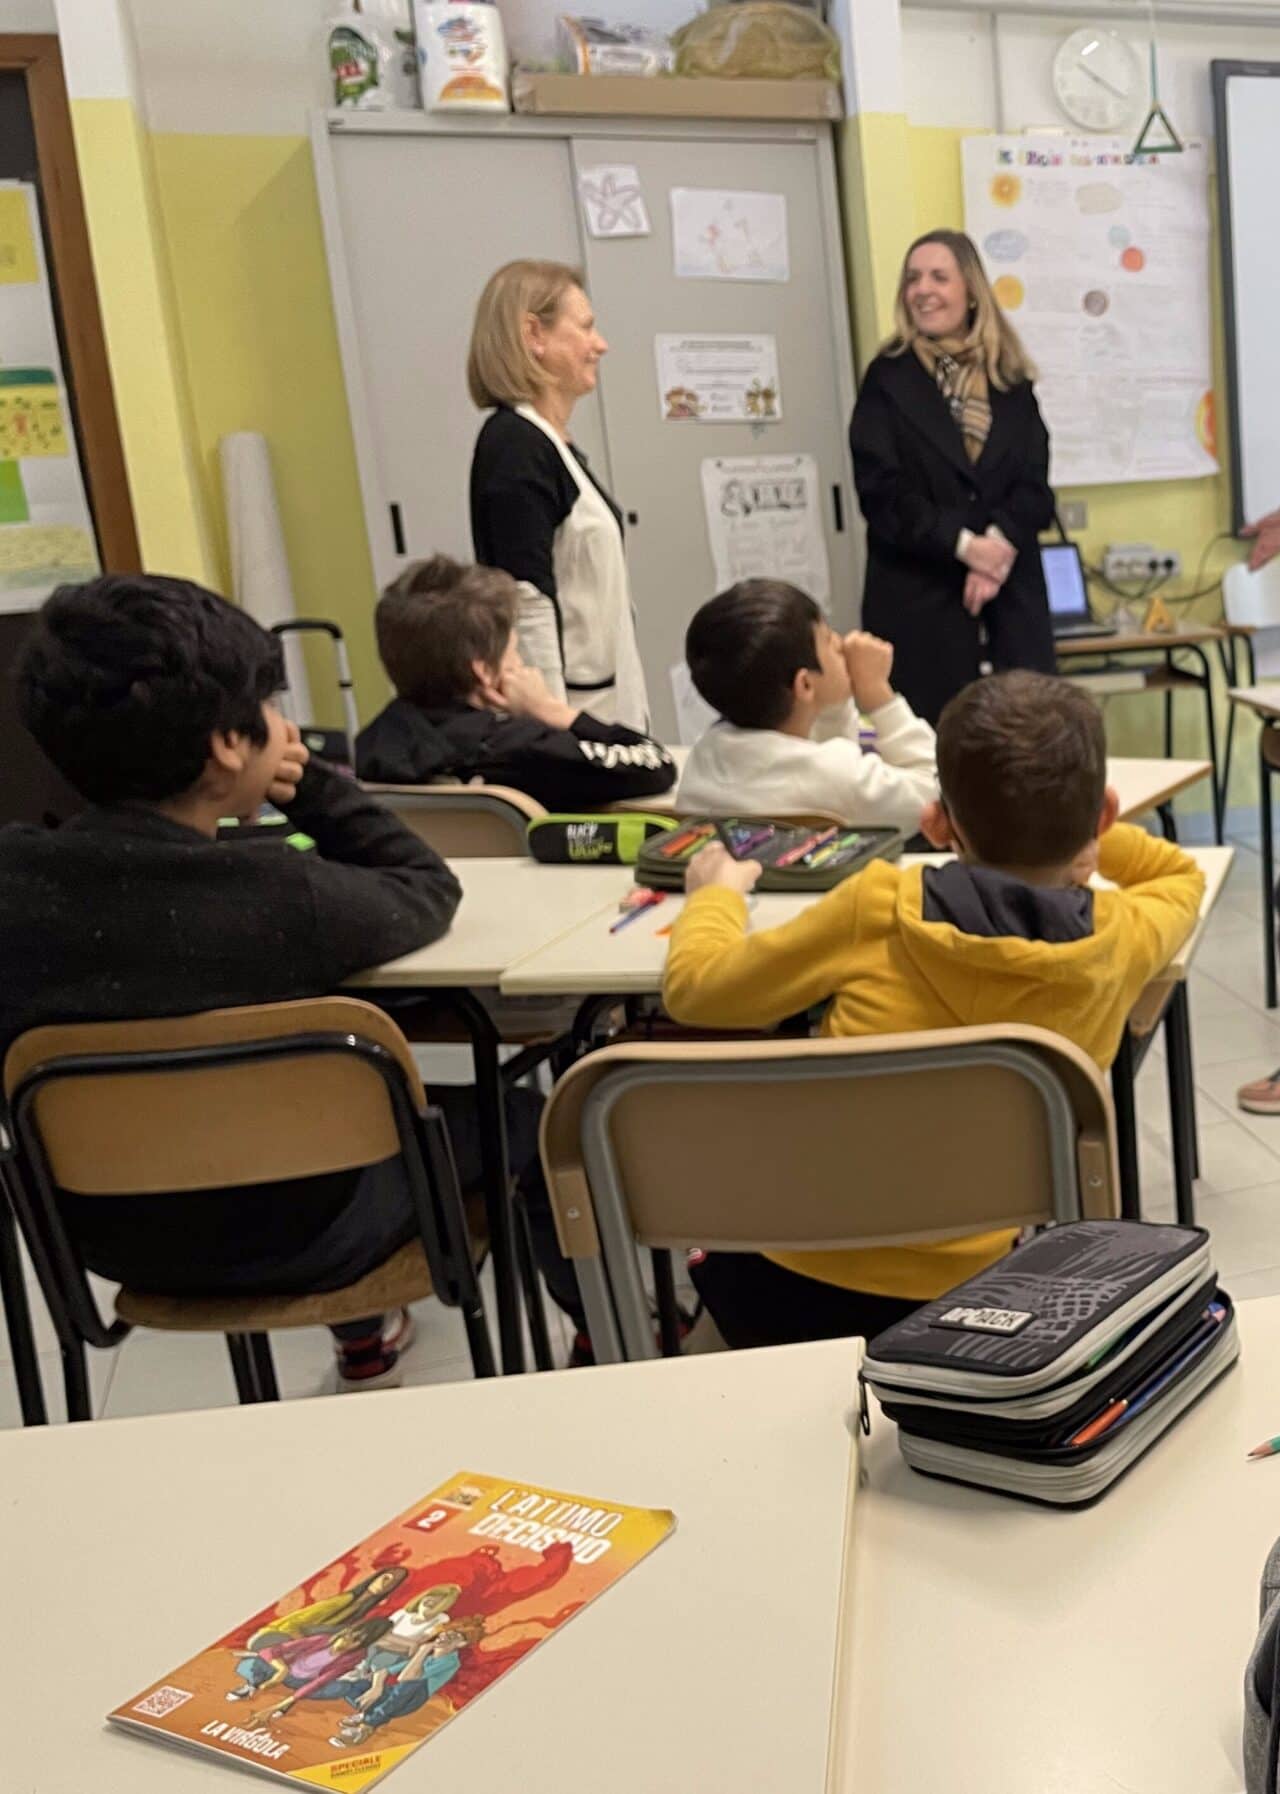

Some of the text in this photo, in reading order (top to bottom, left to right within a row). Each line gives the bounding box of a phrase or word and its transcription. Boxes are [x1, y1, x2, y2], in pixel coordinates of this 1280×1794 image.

[417, 1510, 447, 1528] 2
[490, 1489, 623, 1537] L'ATTIMO
[201, 1720, 290, 1760] LA VIRGOLA
